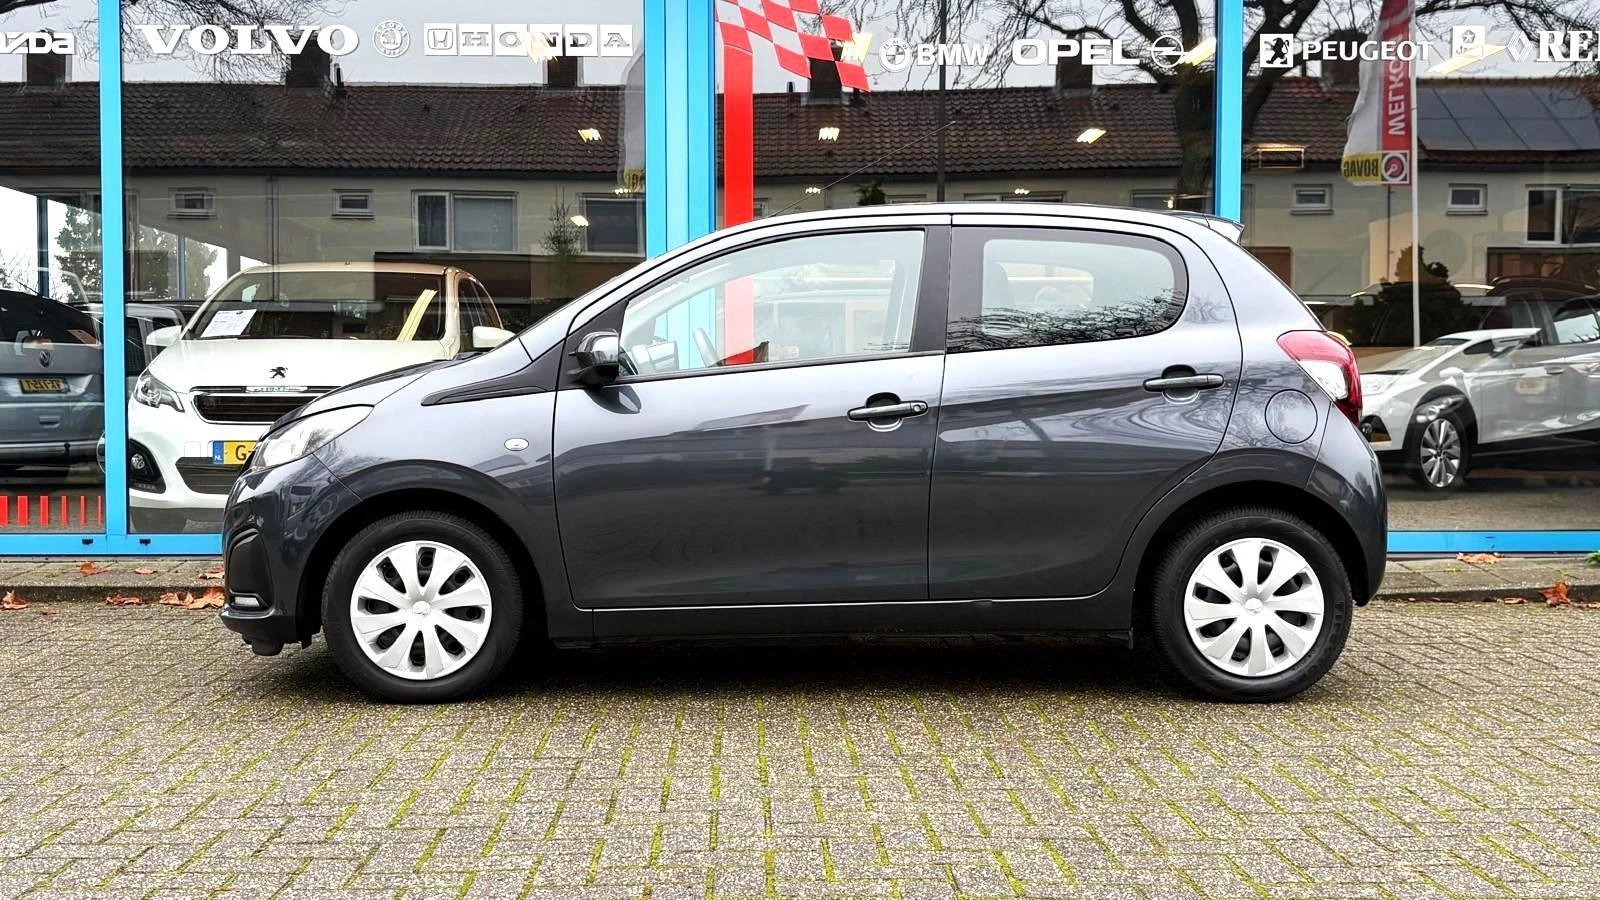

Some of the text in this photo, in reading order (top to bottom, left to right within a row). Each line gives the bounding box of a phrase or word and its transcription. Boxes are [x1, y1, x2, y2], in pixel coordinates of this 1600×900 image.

[134, 24, 360, 56] VOLVO
[461, 31, 630, 49] HONDA
[1012, 38, 1140, 66] OPEL
[1302, 40, 1434, 61] PEUGEOT
[1536, 31, 1600, 62] RE
[916, 43, 990, 66] BMW
